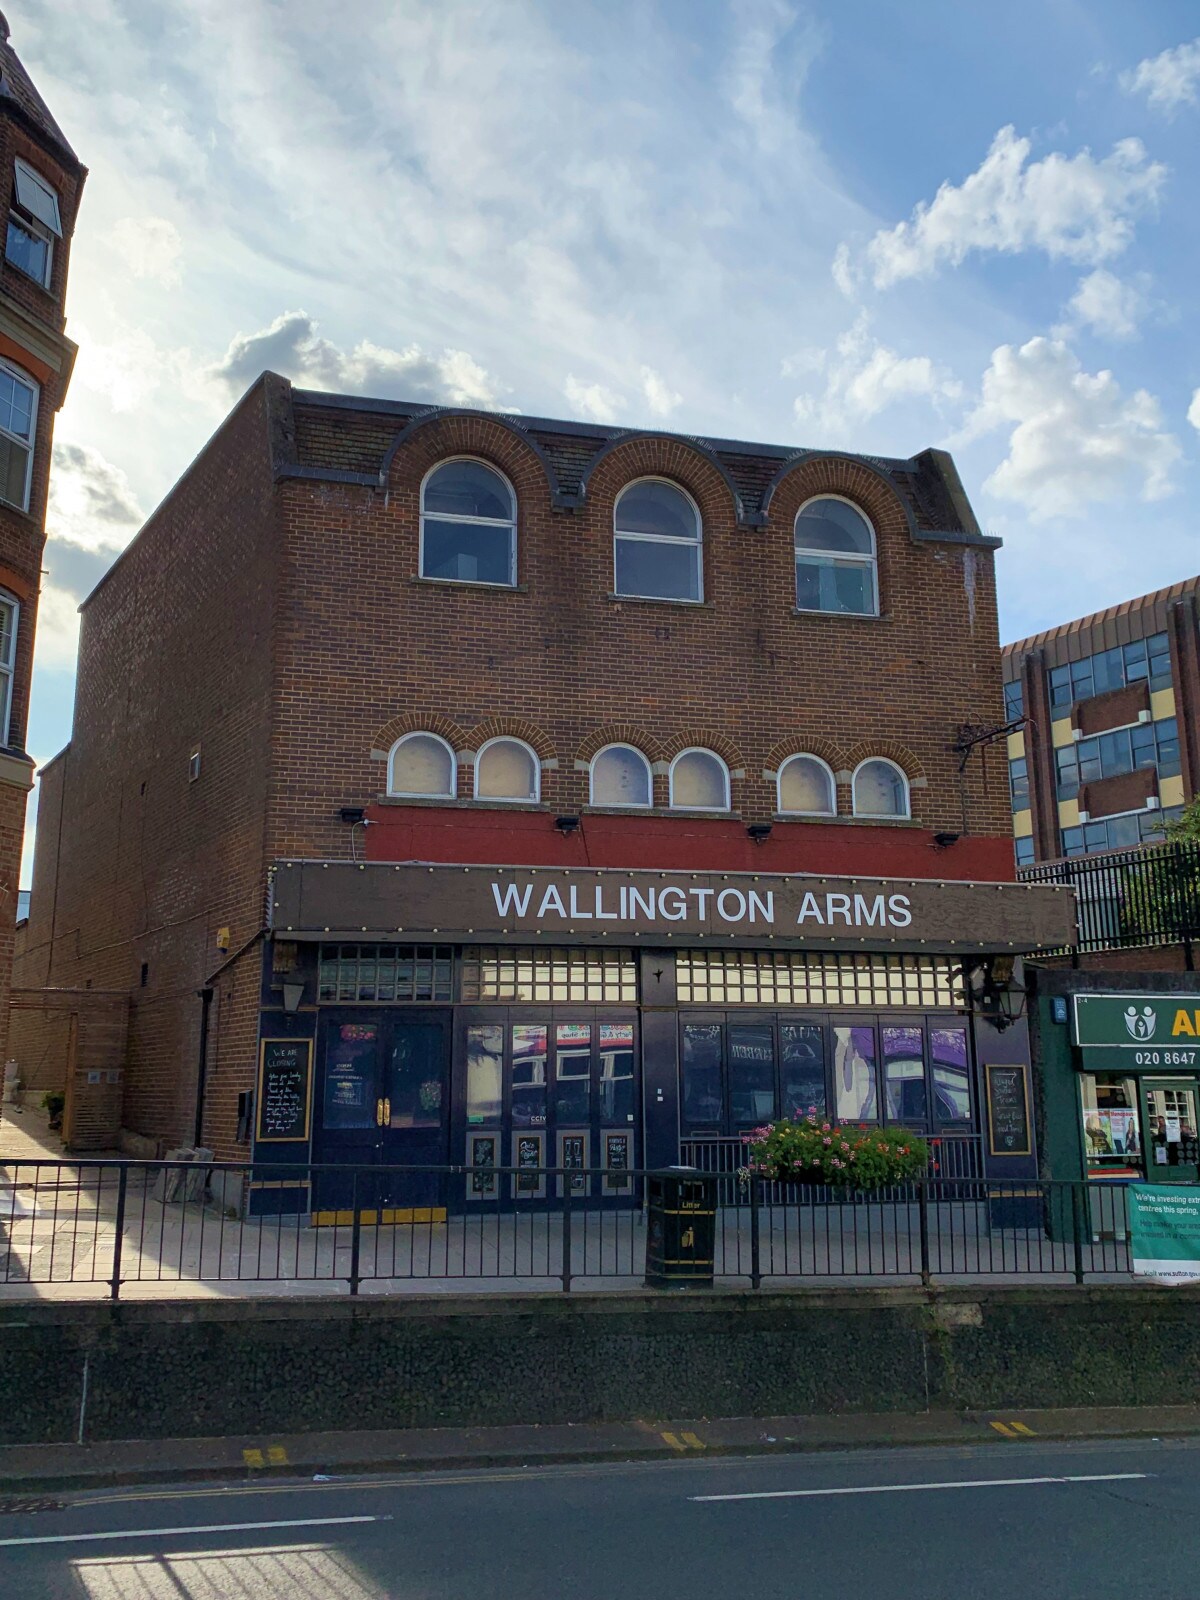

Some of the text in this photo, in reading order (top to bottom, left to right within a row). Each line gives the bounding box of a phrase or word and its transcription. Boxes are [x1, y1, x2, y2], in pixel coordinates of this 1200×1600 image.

[491, 883, 912, 927] WALLINGTON ARMS
[1135, 1052, 1196, 1064] 020 8647
[1135, 1193, 1156, 1202] We're
[1157, 1195, 1187, 1204] investing
[1164, 1206, 1176, 1214] this
